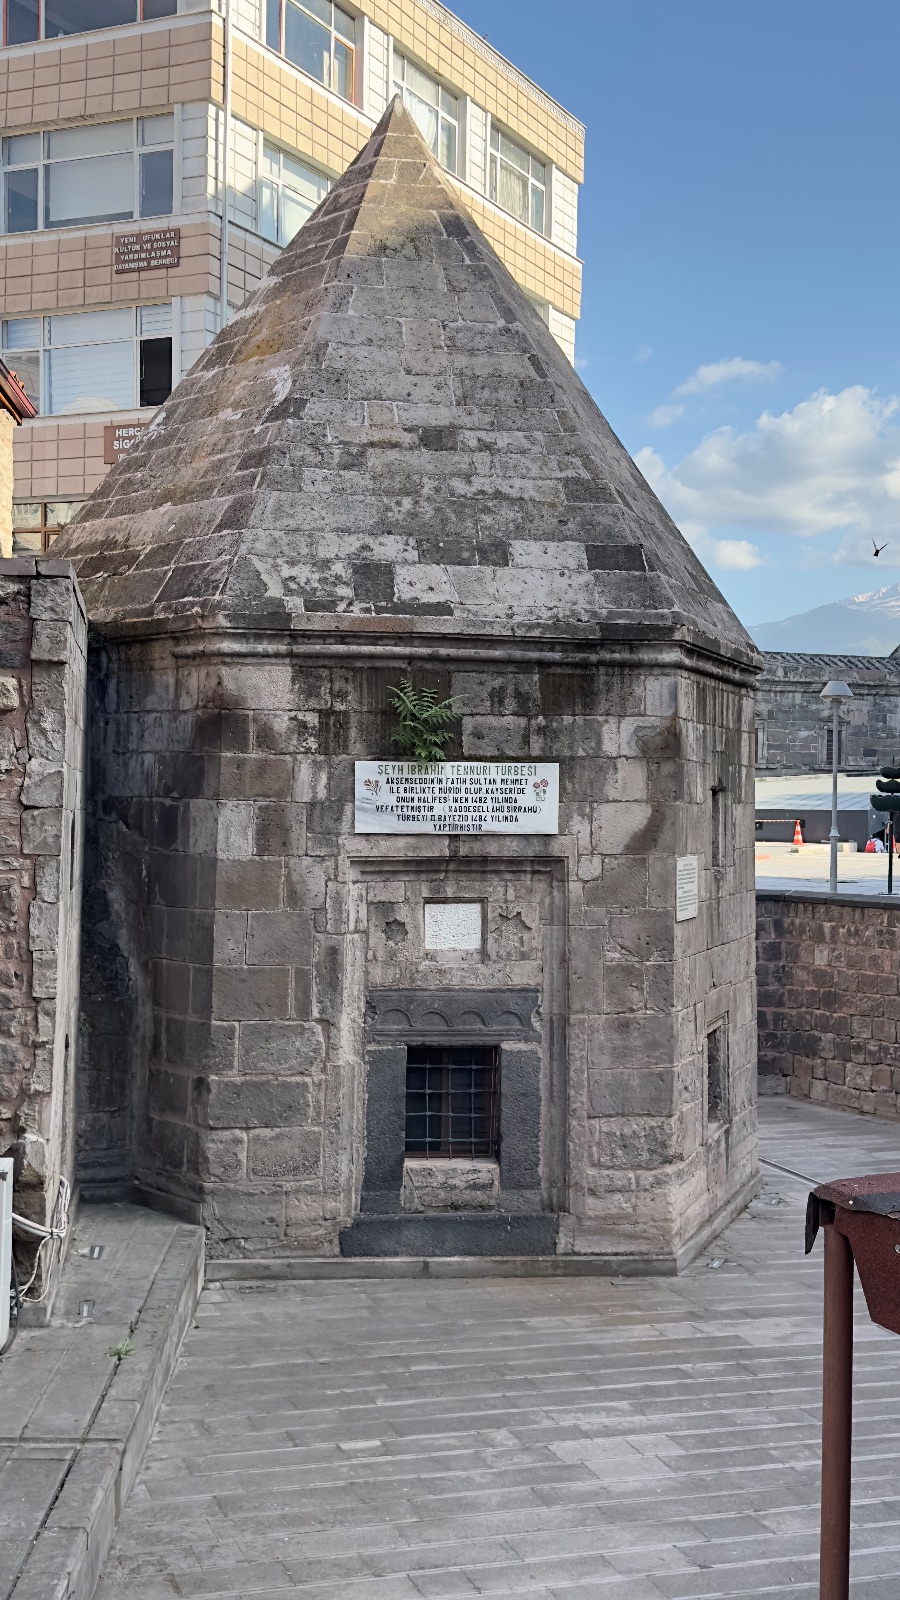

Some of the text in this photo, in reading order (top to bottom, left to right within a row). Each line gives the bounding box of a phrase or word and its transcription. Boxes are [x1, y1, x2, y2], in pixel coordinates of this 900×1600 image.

[143, 232, 175, 241] UFUKLAR
[154, 240, 178, 248] SOSYAL
[378, 764, 403, 776] ŞEYH
